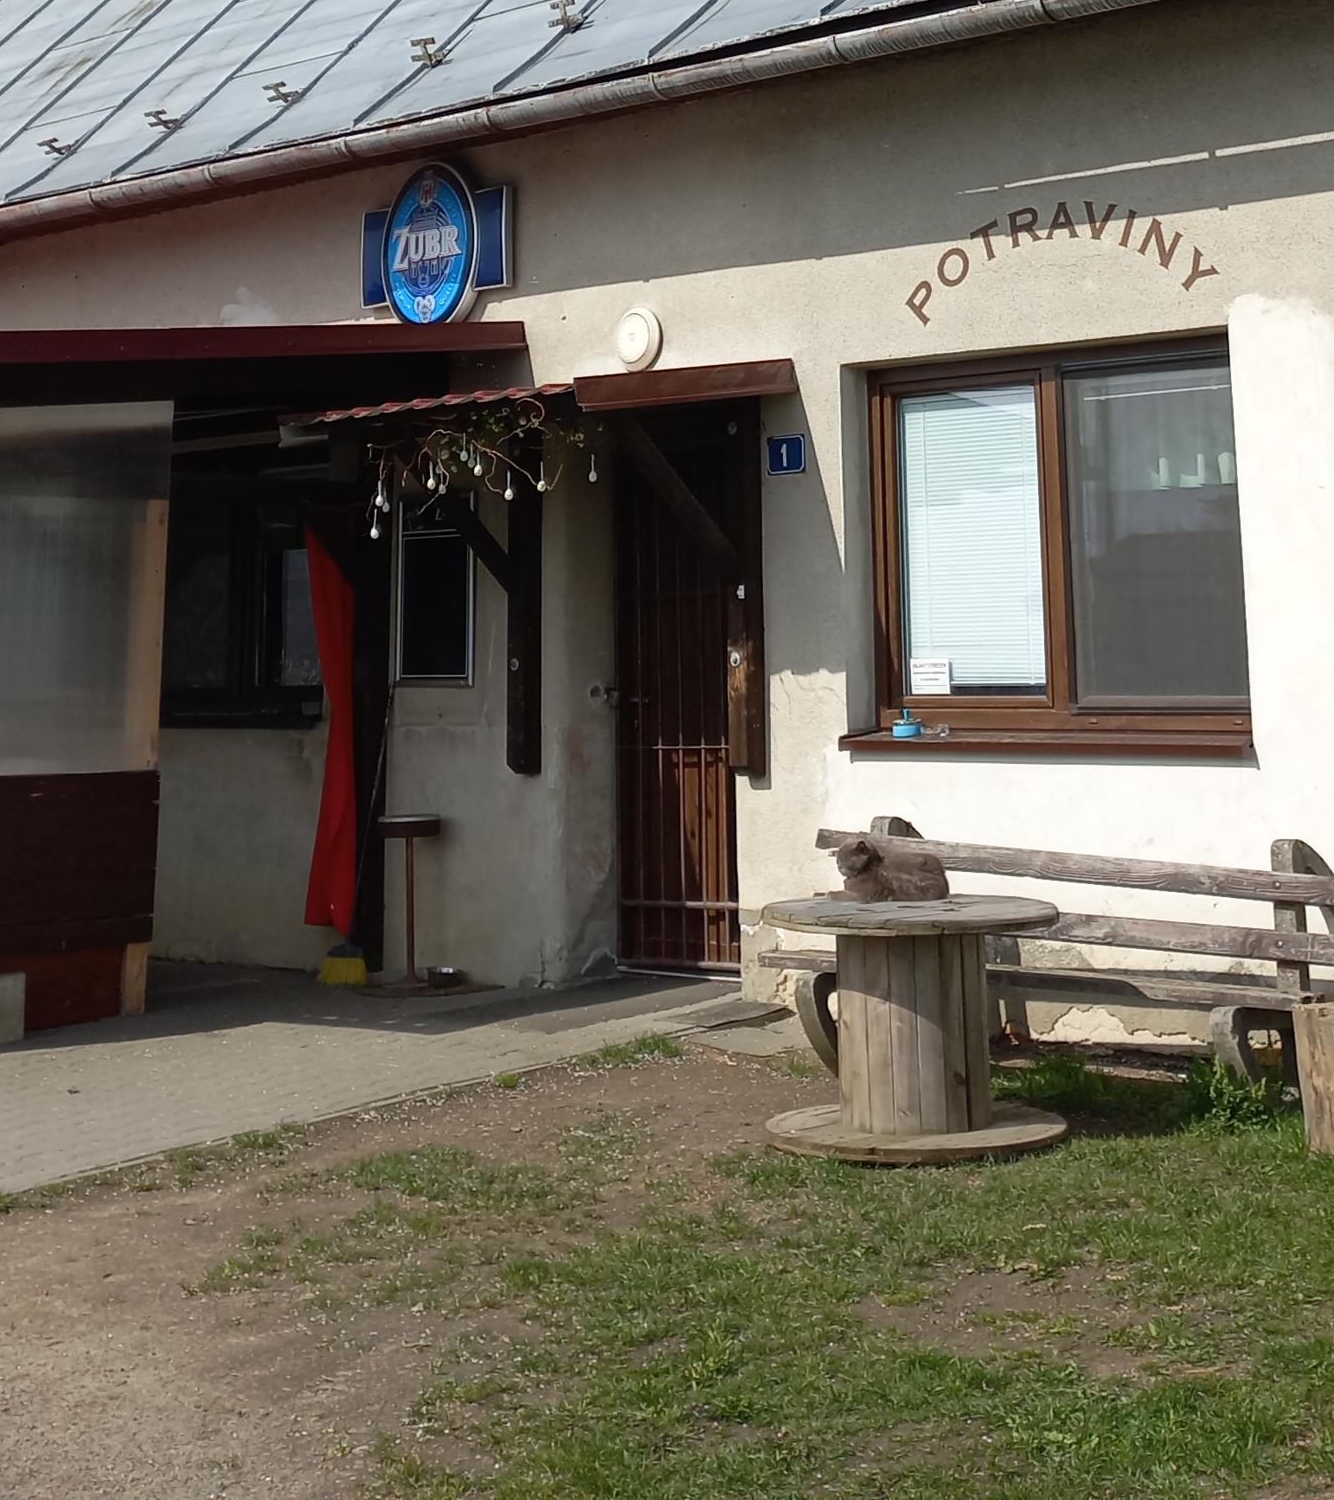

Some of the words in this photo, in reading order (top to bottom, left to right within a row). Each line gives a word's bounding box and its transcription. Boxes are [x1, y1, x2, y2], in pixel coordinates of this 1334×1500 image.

[391, 224, 462, 272] ZUBR
[905, 200, 1220, 326] POTRAVINY
[780, 443, 788, 468] 1
